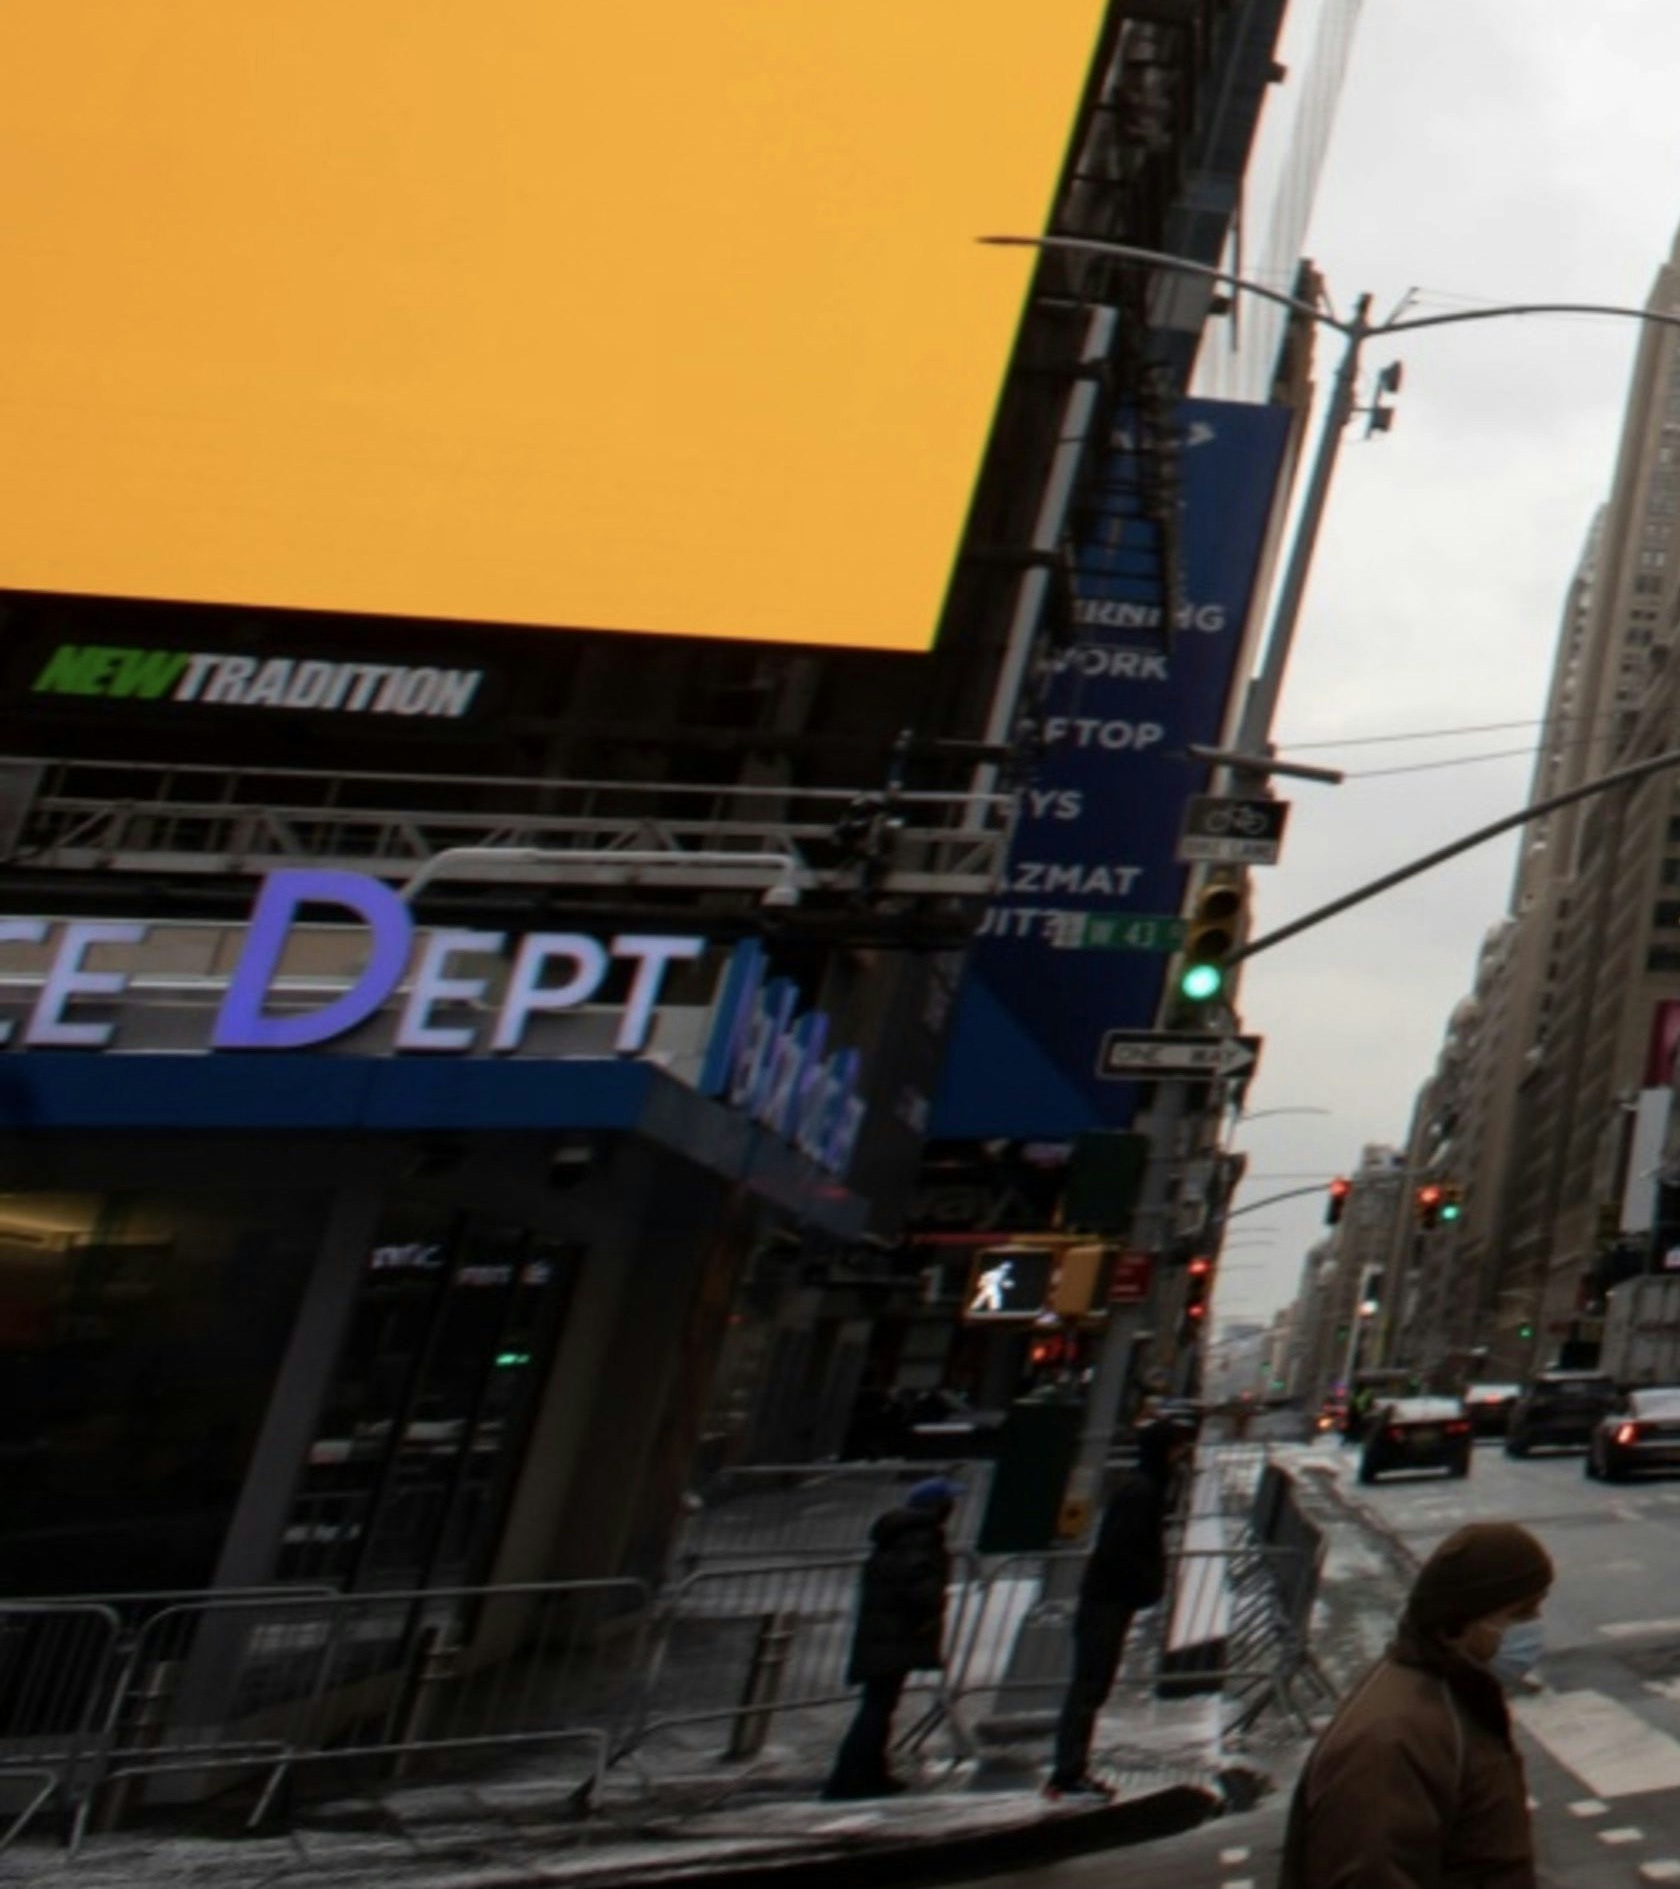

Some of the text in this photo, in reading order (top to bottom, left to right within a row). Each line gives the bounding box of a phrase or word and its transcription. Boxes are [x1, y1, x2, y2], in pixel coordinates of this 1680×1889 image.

[32, 645, 488, 720] NEW TRADITION
[213, 867, 705, 1052] DEPT
